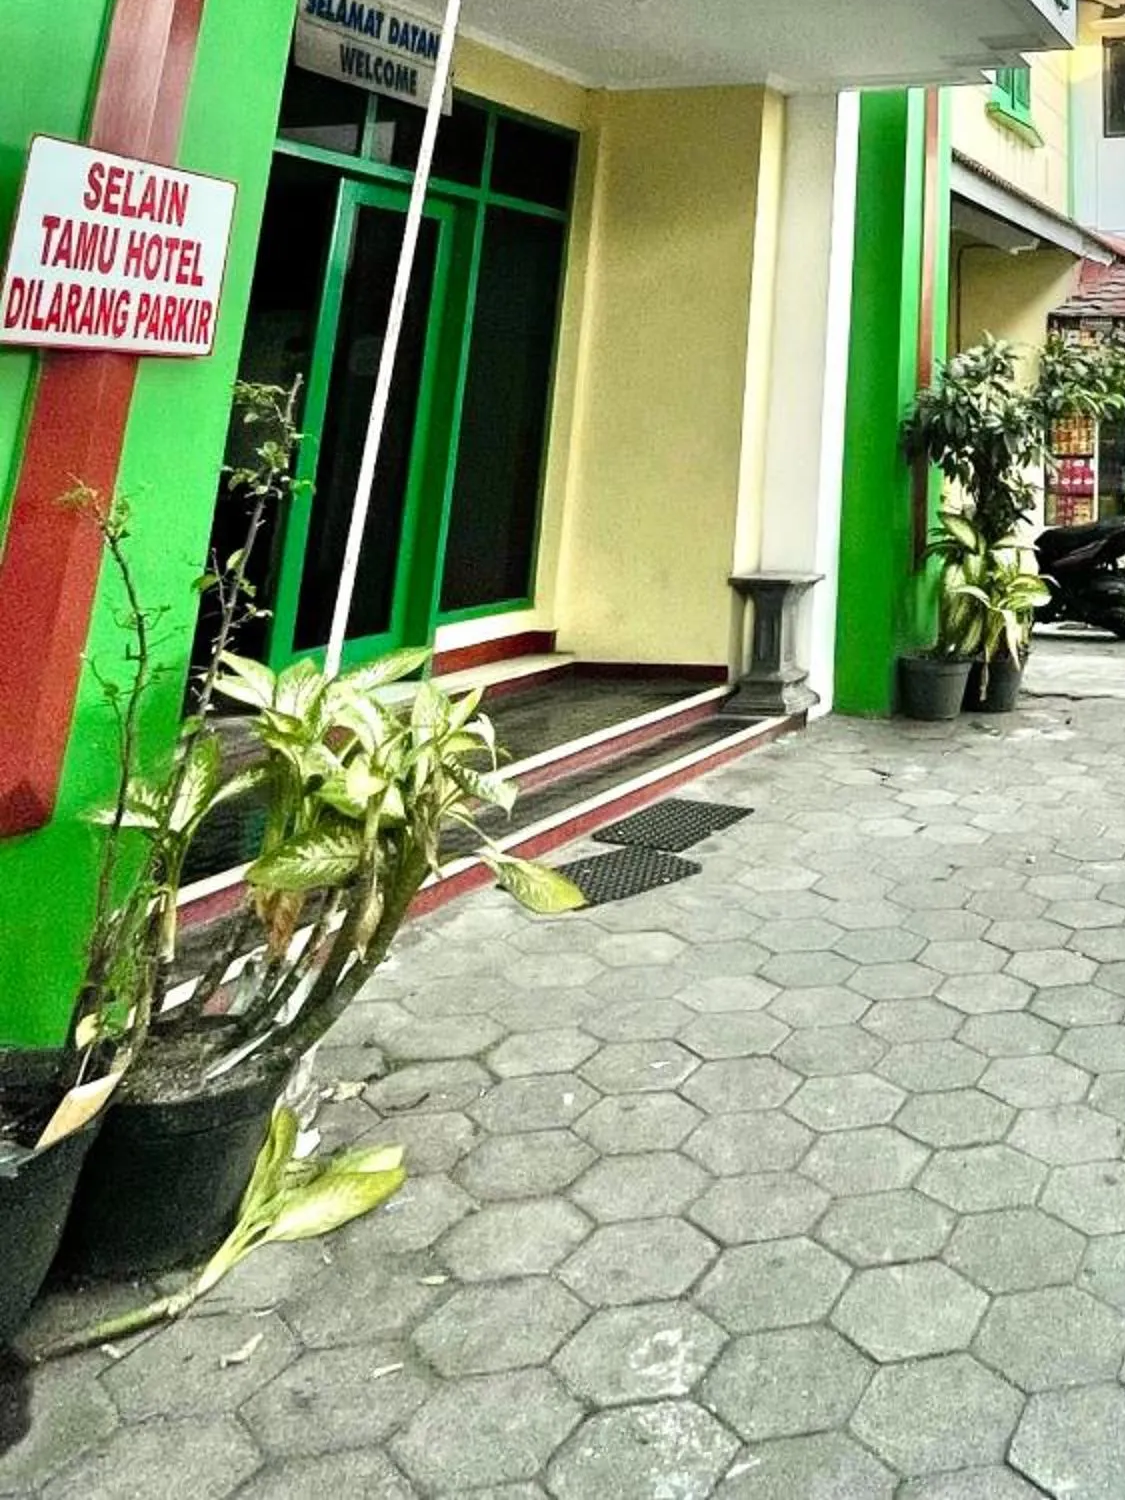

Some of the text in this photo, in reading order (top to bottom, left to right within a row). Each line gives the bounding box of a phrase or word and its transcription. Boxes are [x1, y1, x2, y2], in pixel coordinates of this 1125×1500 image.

[340, 43, 418, 97] WELCOME
[388, 17, 441, 61] DATAN
[83, 161, 190, 228] SELAIN
[40, 214, 204, 287] TAMU HOTEL
[3, 276, 213, 345] DILARANG PARKIR
